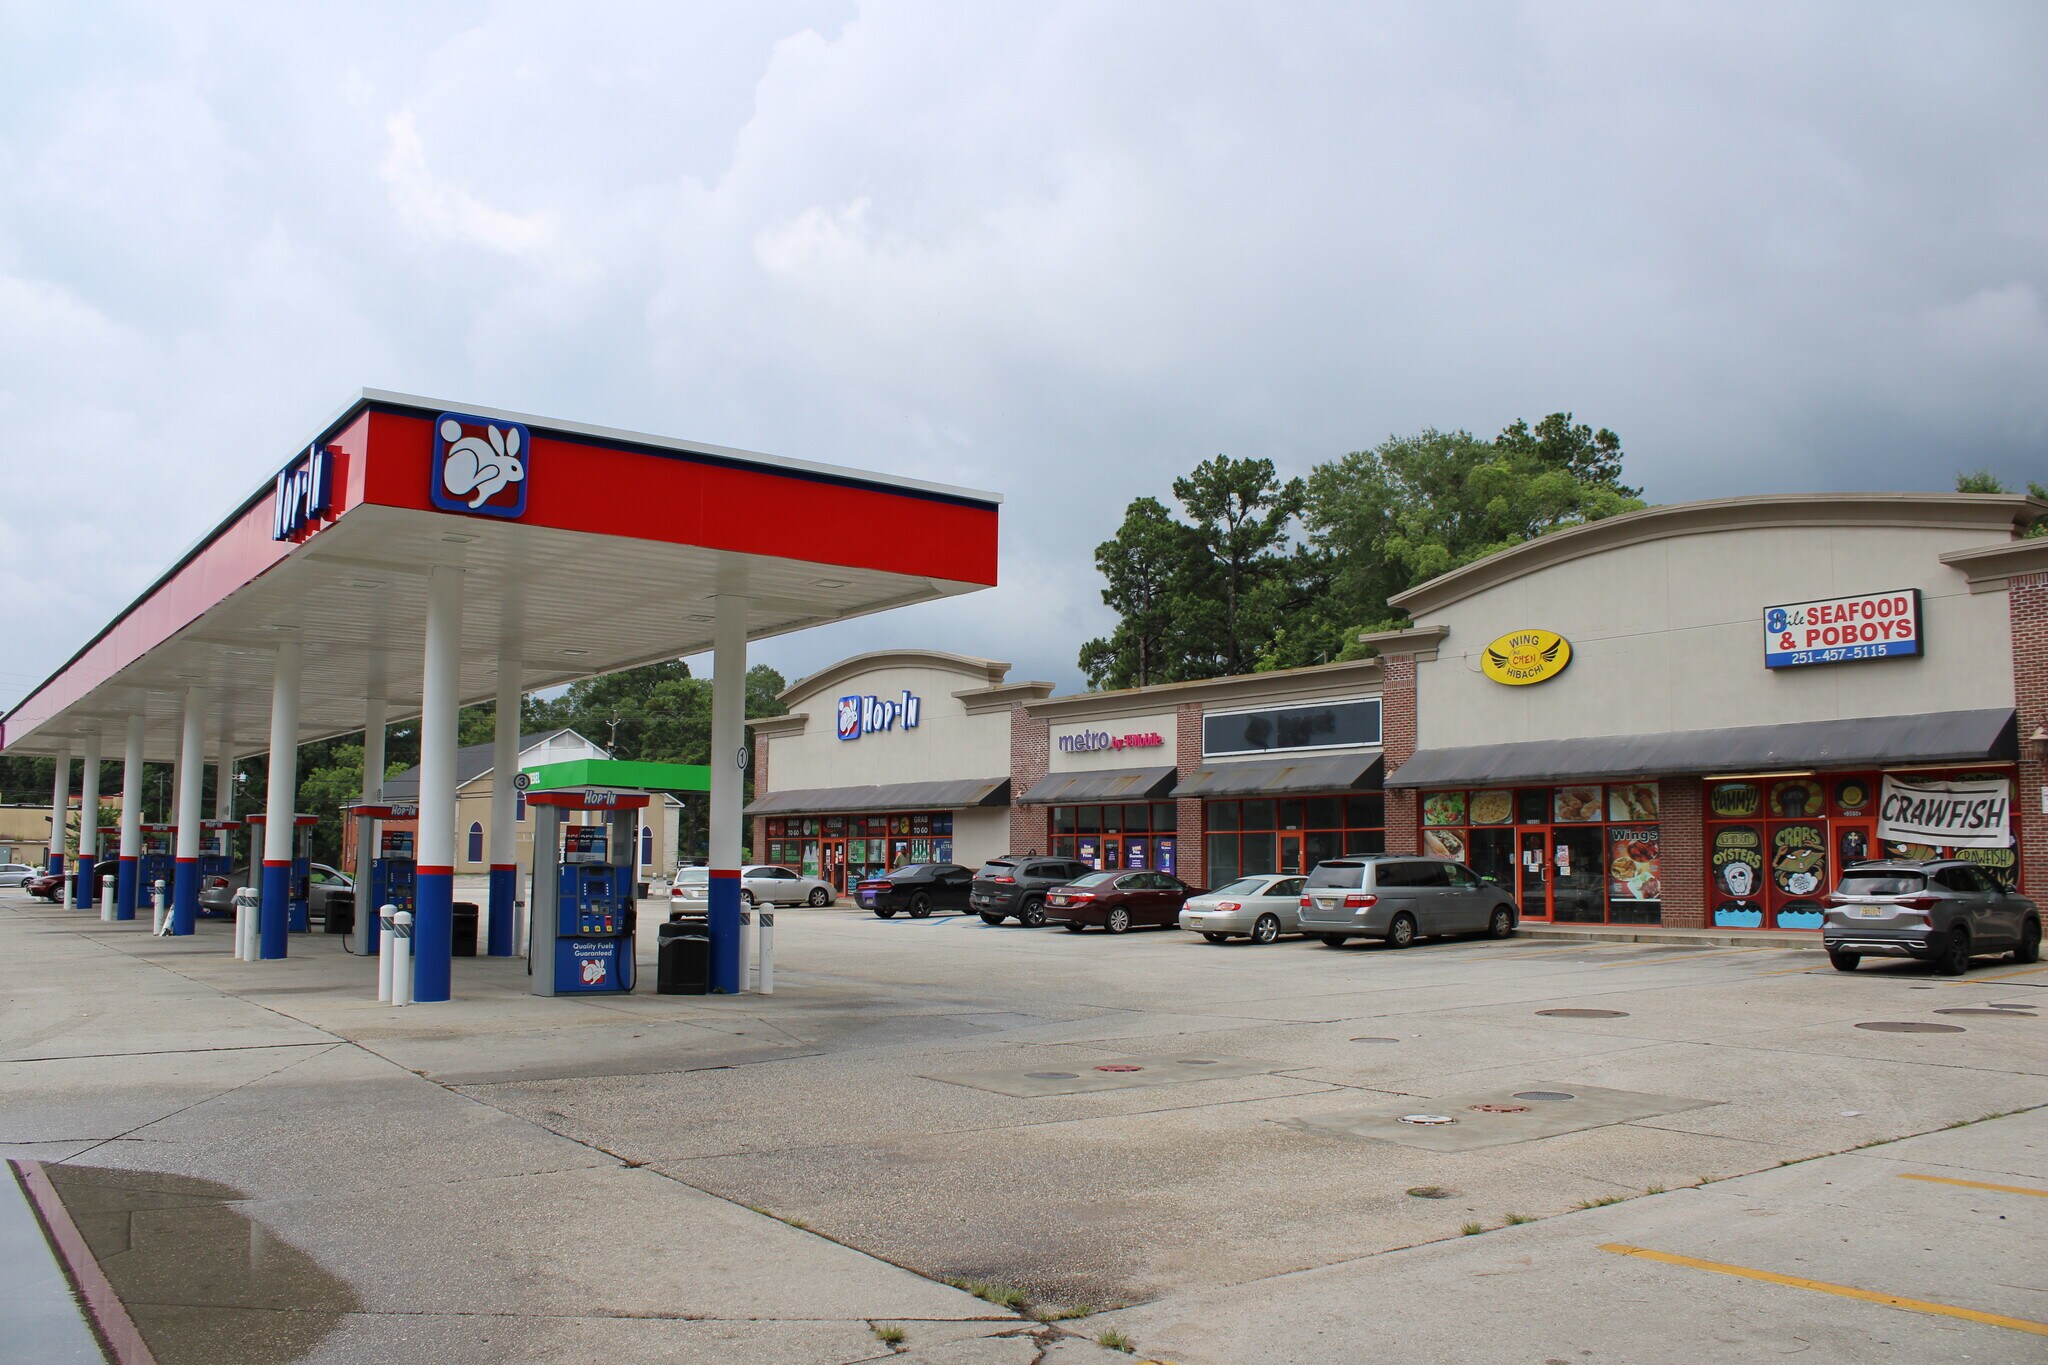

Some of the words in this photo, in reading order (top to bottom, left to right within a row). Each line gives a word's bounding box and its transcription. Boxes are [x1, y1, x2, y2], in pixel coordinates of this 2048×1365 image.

[1767, 608, 1788, 634] 8
[1807, 597, 1908, 626] SEAFOOD
[1509, 634, 1539, 649] WING
[1780, 632, 1797, 650] &
[1806, 619, 1912, 648] POBOYS
[1512, 654, 1537, 665] CHEN
[1792, 645, 1887, 665] 251-457-5115
[1506, 664, 1544, 679] HIBACHI
[1059, 729, 1109, 753] metro
[1111, 736, 1123, 752] by
[526, 772, 541, 785] ESEL
[1712, 787, 1757, 813] YUMMY!
[1881, 793, 2006, 829] CRAWFISH
[1612, 828, 1659, 843] Wings
[1775, 827, 1821, 847] CRABS
[373, 860, 378, 868] 3
[1713, 849, 1762, 869] OYSTERS
[560, 866, 565, 876] 1
[573, 942, 596, 951] Quality
[597, 942, 614, 950] Fuels
